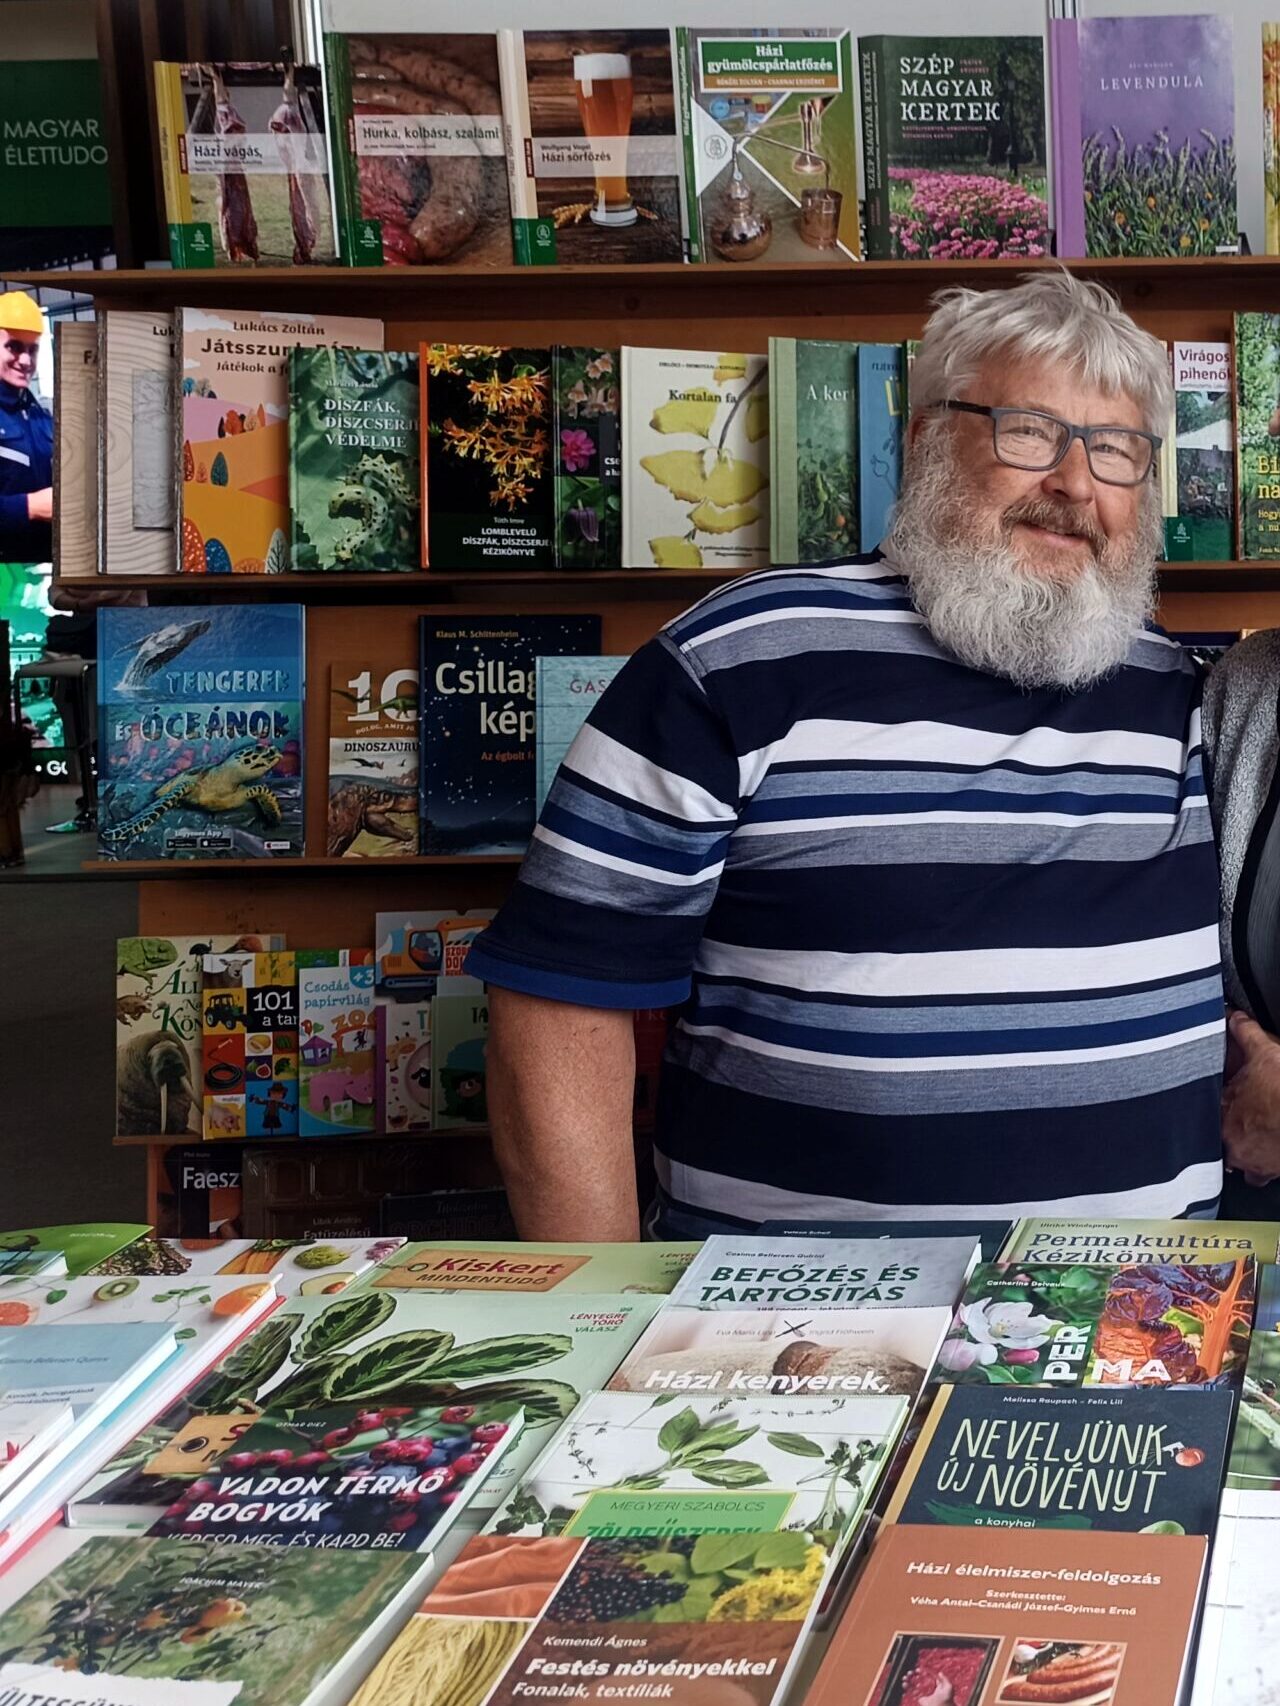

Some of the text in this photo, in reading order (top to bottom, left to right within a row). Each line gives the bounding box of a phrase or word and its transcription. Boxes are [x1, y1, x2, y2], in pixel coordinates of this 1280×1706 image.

[756, 45, 783, 56] Házi
[707, 57, 833, 74] gyümölcspárlatfőzés
[901, 54, 954, 75] SZÉP
[901, 80, 993, 97] MAGYAR
[1101, 76, 1204, 91] LEVENDULA
[901, 102, 1000, 121] KERTEK
[4, 120, 99, 137] MAGYAR
[363, 126, 499, 140] Hurka, kolbász, szalámi
[194, 144, 263, 159] Házi vágás,
[542, 151, 611, 162] Házi sörfőzés
[233, 320, 325, 335] Lukács Zoltán
[217, 361, 277, 374] Játékok a
[669, 389, 721, 403] Kortalan
[807, 386, 818, 400] A
[324, 396, 400, 414] DÍSZFÁK,
[325, 432, 406, 447] VÉDELME
[481, 526, 537, 537] LOMBLEVELŰ
[463, 535, 500, 546] DÍSZFÁK,
[483, 546, 535, 557] KÉZIKÖNYVE
[166, 670, 289, 694] TENGEREK
[115, 706, 289, 741] ÉS ÓCEÁNOK
[481, 752, 493, 760] Az
[305, 981, 350, 994] Csodás
[253, 992, 294, 1011] 101
[305, 995, 370, 1010] papírvilág
[1029, 1232, 1252, 1251] Permakultúra
[438, 1256, 564, 1276] Kiskert
[711, 1263, 920, 1282] BEFŐZÉS ÉS
[416, 1272, 548, 1287] MINDENTUDÓ
[986, 1279, 1028, 1288] Catherine
[701, 1282, 905, 1301] TARTÓSÍTÁS
[644, 1368, 889, 1394] Házi kenyerek,
[950, 1416, 1168, 1466] NEVELJÜNK
[218, 1473, 445, 1496] VADON TERMŐ
[938, 1457, 1166, 1513] ÚJ NÖVÉNYT
[186, 1500, 334, 1522] BOGYÓK
[610, 1501, 766, 1512] MEGYERI SZABOLCS
[974, 1516, 1036, 1529] a konyhai
[316, 1533, 406, 1548] KAPD BE!
[907, 1561, 1161, 1586] Házi élelmiszer-feldolgozás
[986, 1589, 1066, 1601] Szerkesztette:
[910, 1596, 1136, 1616] Véha Ernő
[543, 1634, 647, 1649] Kemendi Ágnes
[525, 1657, 775, 1681] Festés növényekkel
[512, 1682, 674, 1699] Fonalak, textíliák
